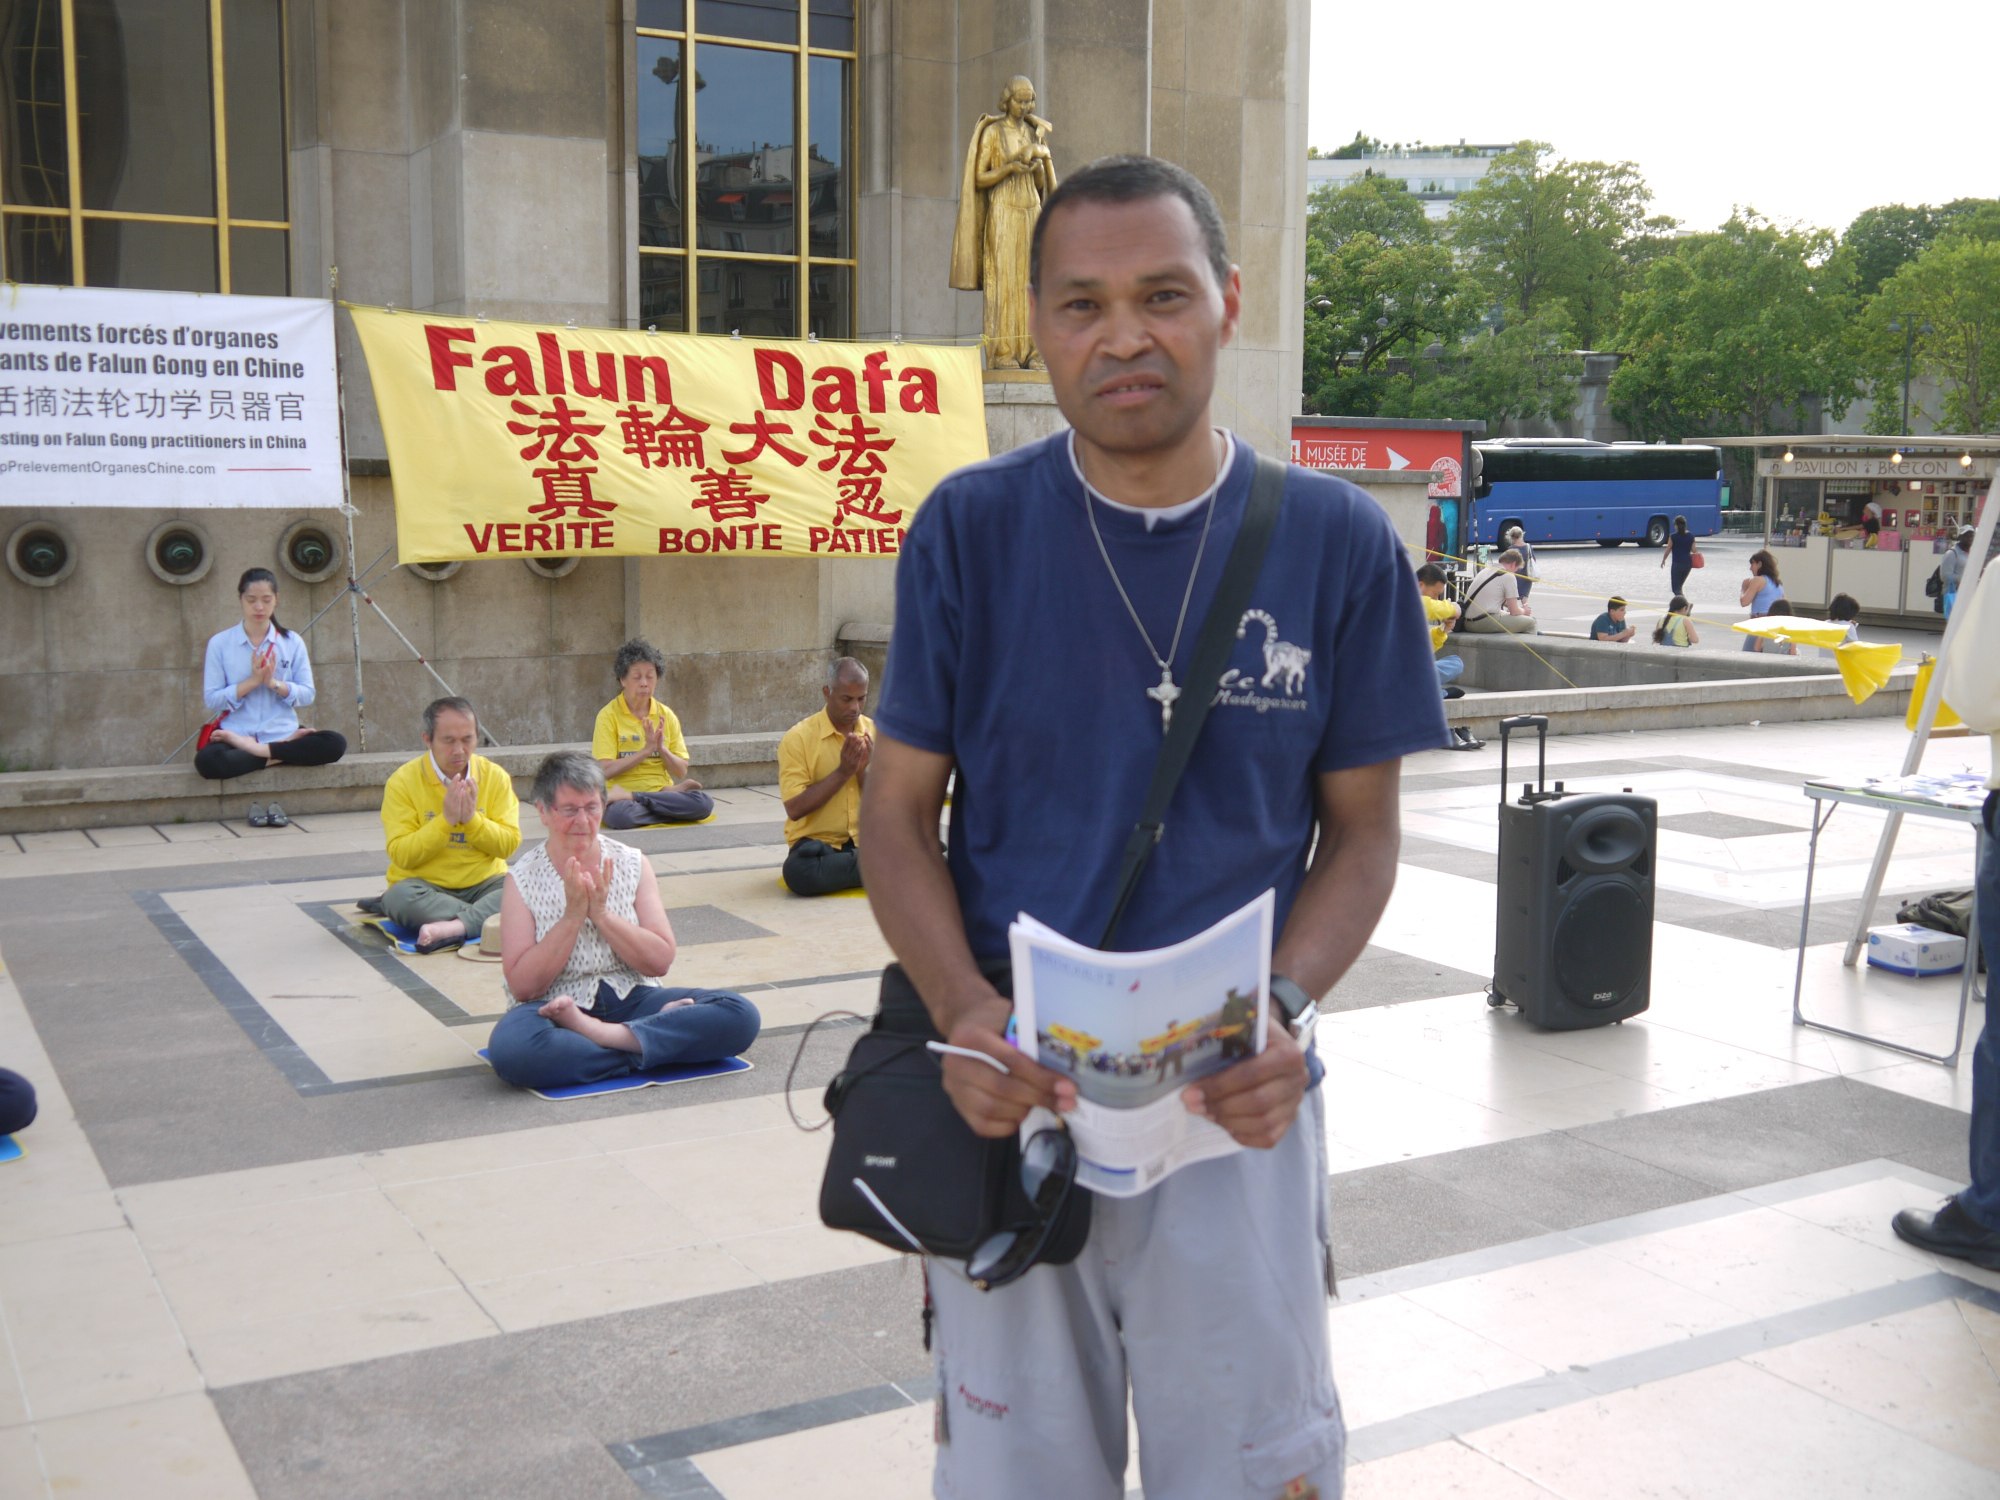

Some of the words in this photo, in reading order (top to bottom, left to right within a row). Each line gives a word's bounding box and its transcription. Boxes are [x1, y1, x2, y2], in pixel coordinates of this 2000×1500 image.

[97, 323, 167, 345] forcés
[173, 326, 279, 350] d'organes
[54, 351, 81, 372] de
[88, 352, 146, 374] Falun
[152, 355, 207, 378] Gong
[213, 359, 239, 377] en
[244, 357, 304, 378] Chine
[424, 325, 673, 405] Falun
[754, 348, 941, 414] Dafa
[43, 434, 62, 446] on
[66, 432, 106, 447] Falun
[110, 433, 147, 449] Gong
[151, 434, 246, 449] practitioners
[249, 436, 263, 449] in
[266, 436, 307, 449] China
[1307, 444, 1347, 461] MUSÉE
[1352, 447, 1367, 461] DE
[1795, 461, 1857, 475] PAVILLON
[1877, 461, 1948, 475] BRETON
[528, 461, 618, 522] 真
[691, 468, 771, 523] 善
[832, 477, 903, 526] 忍
[463, 521, 614, 553] VERITE
[658, 523, 783, 553] BONTE
